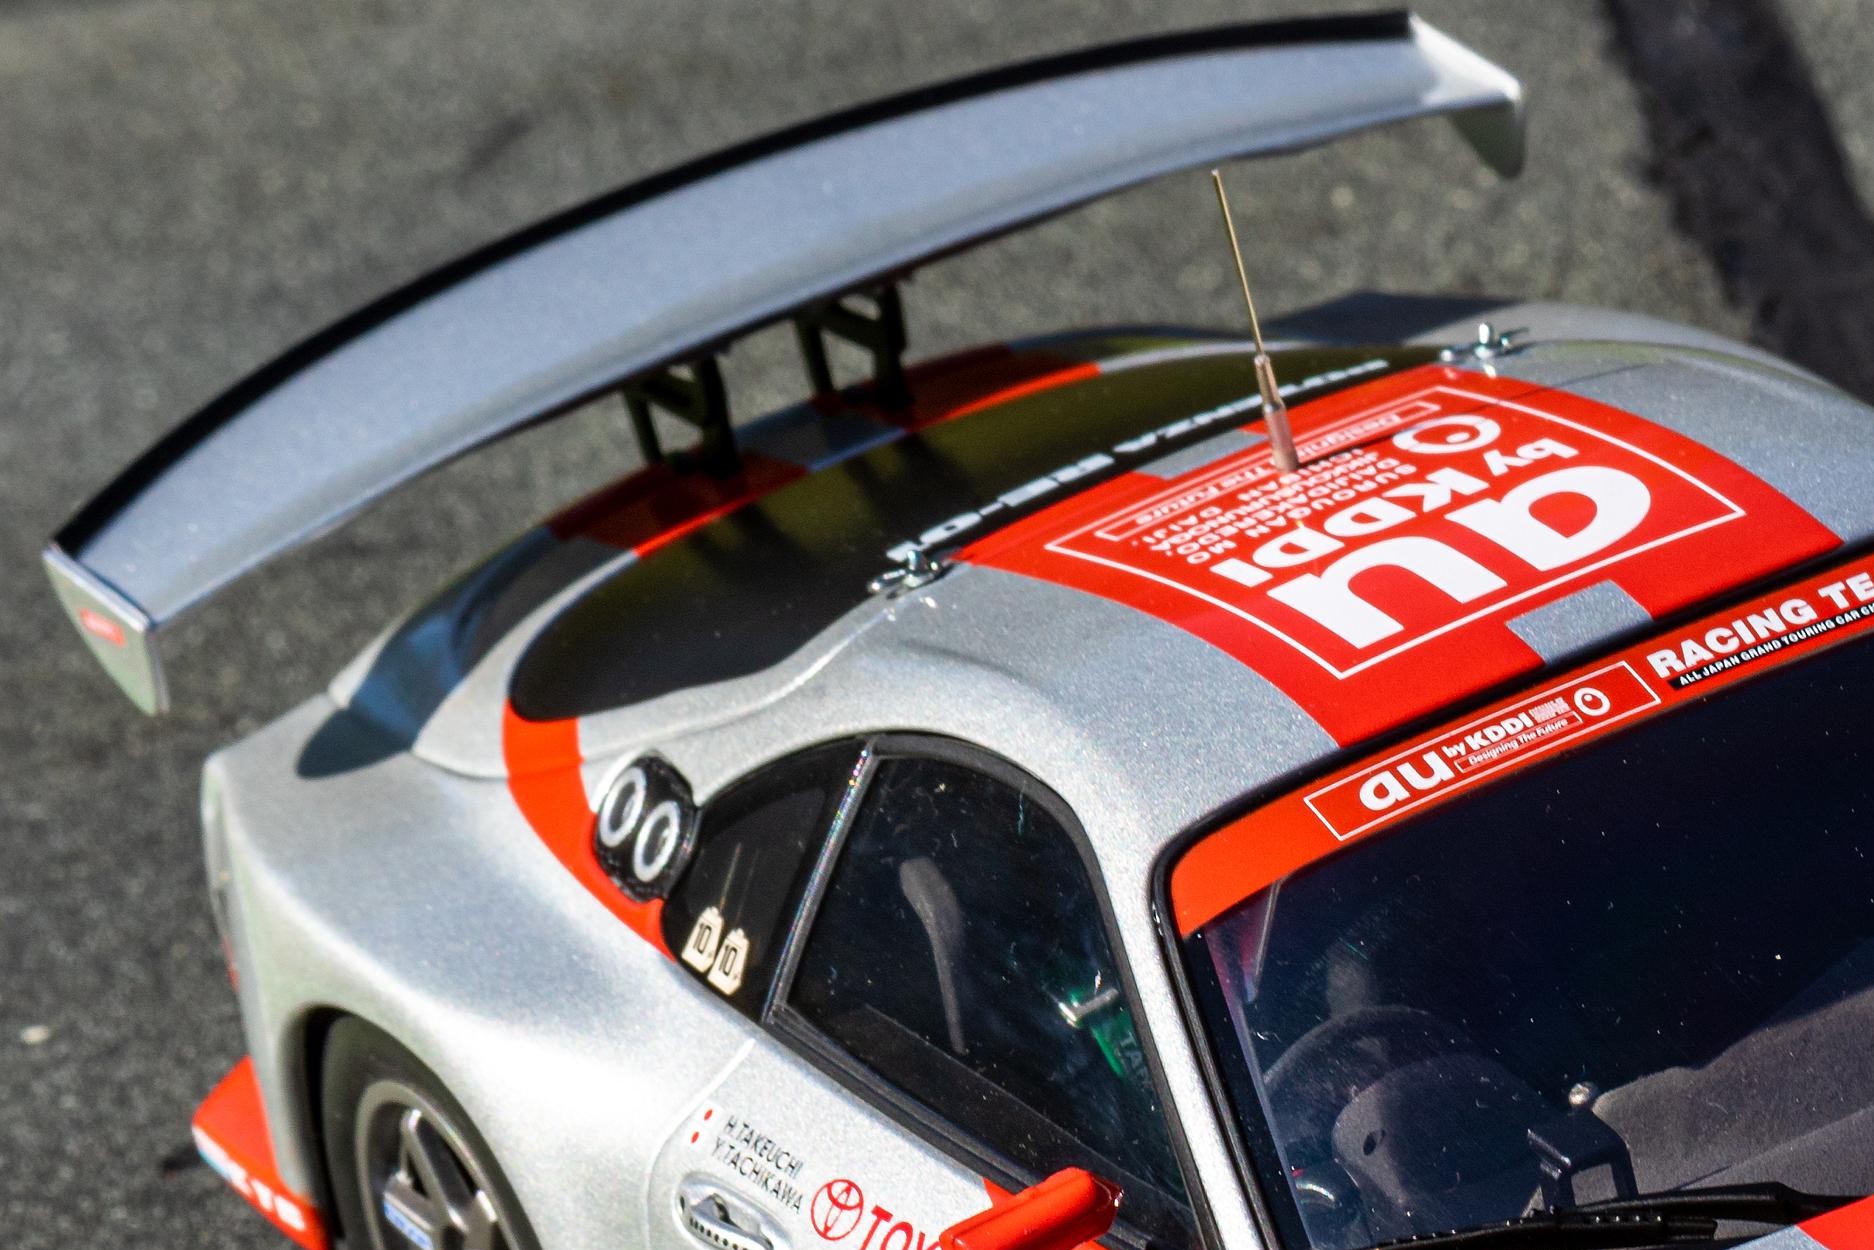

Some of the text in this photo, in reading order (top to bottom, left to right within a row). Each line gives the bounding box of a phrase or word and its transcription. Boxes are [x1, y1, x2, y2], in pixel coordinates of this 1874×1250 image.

[1210, 439, 1580, 587] by KDDI
[1187, 540, 1237, 564] MO
[1267, 465, 1651, 649] au
[1646, 598, 1818, 679] RACING
[1679, 670, 1702, 686] ALL
[1702, 656, 1741, 680] JAPAN
[1741, 639, 1782, 663] GRAND
[1781, 618, 1836, 647] TOURING
[1835, 606, 1861, 625] CAR
[1442, 712, 1534, 759] by KDDI
[1468, 718, 1569, 766] Designing The Future
[1358, 750, 1456, 812] au
[711, 1136, 804, 1215] Y.TACHIKAWA
[725, 1114, 804, 1179] H.TAKEUCHI
